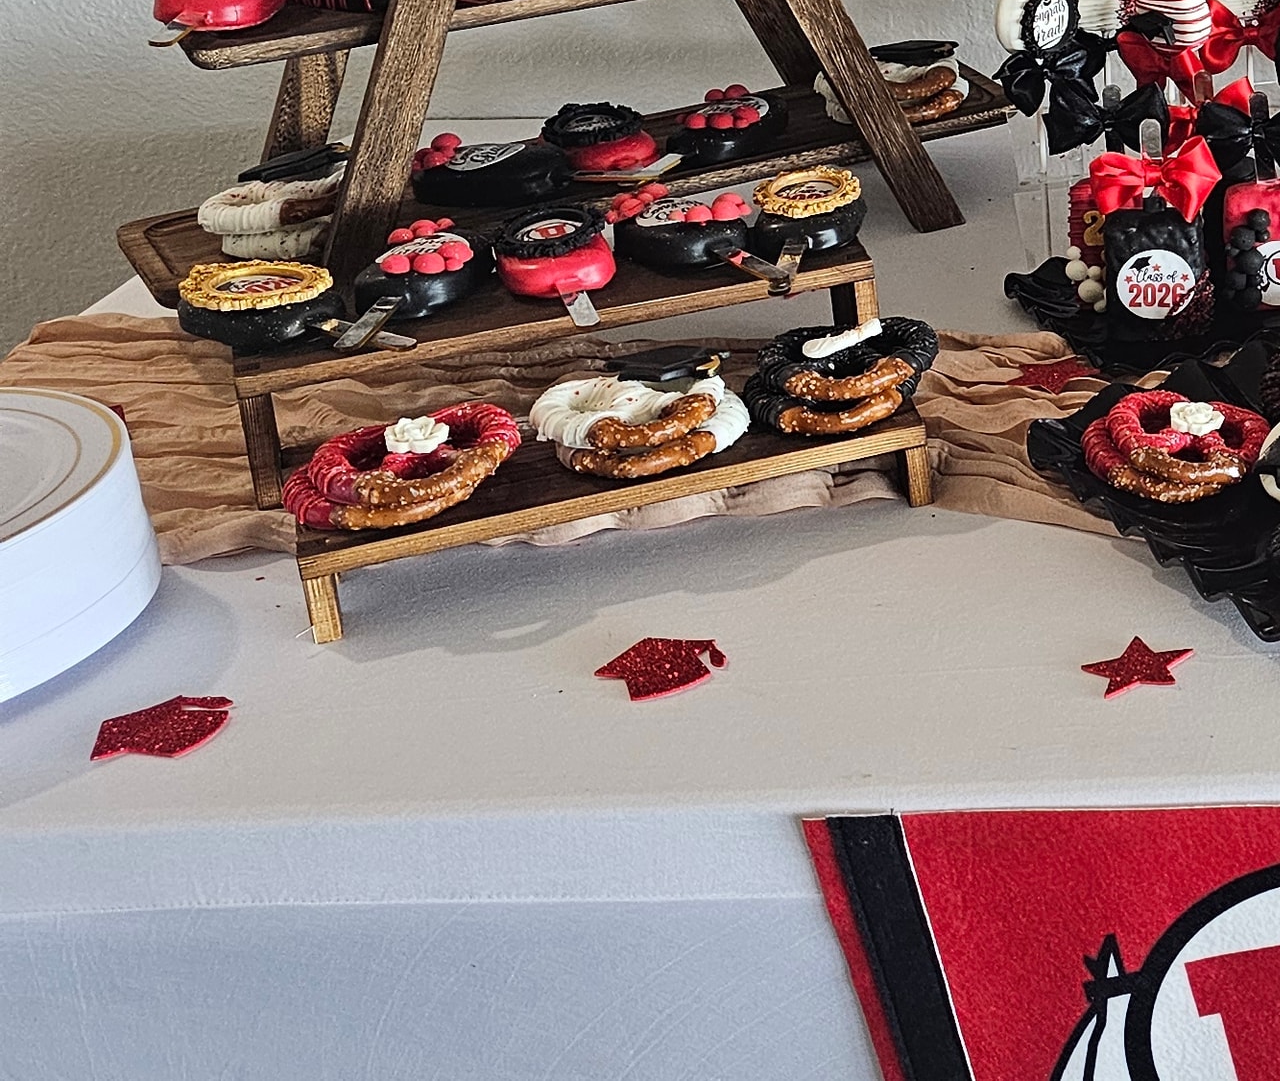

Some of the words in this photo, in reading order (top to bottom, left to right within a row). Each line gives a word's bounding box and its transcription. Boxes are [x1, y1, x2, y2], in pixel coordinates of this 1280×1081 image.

[1135, 269, 1163, 283] Class
[1166, 270, 1178, 282] of
[1128, 283, 1185, 308] 2026
